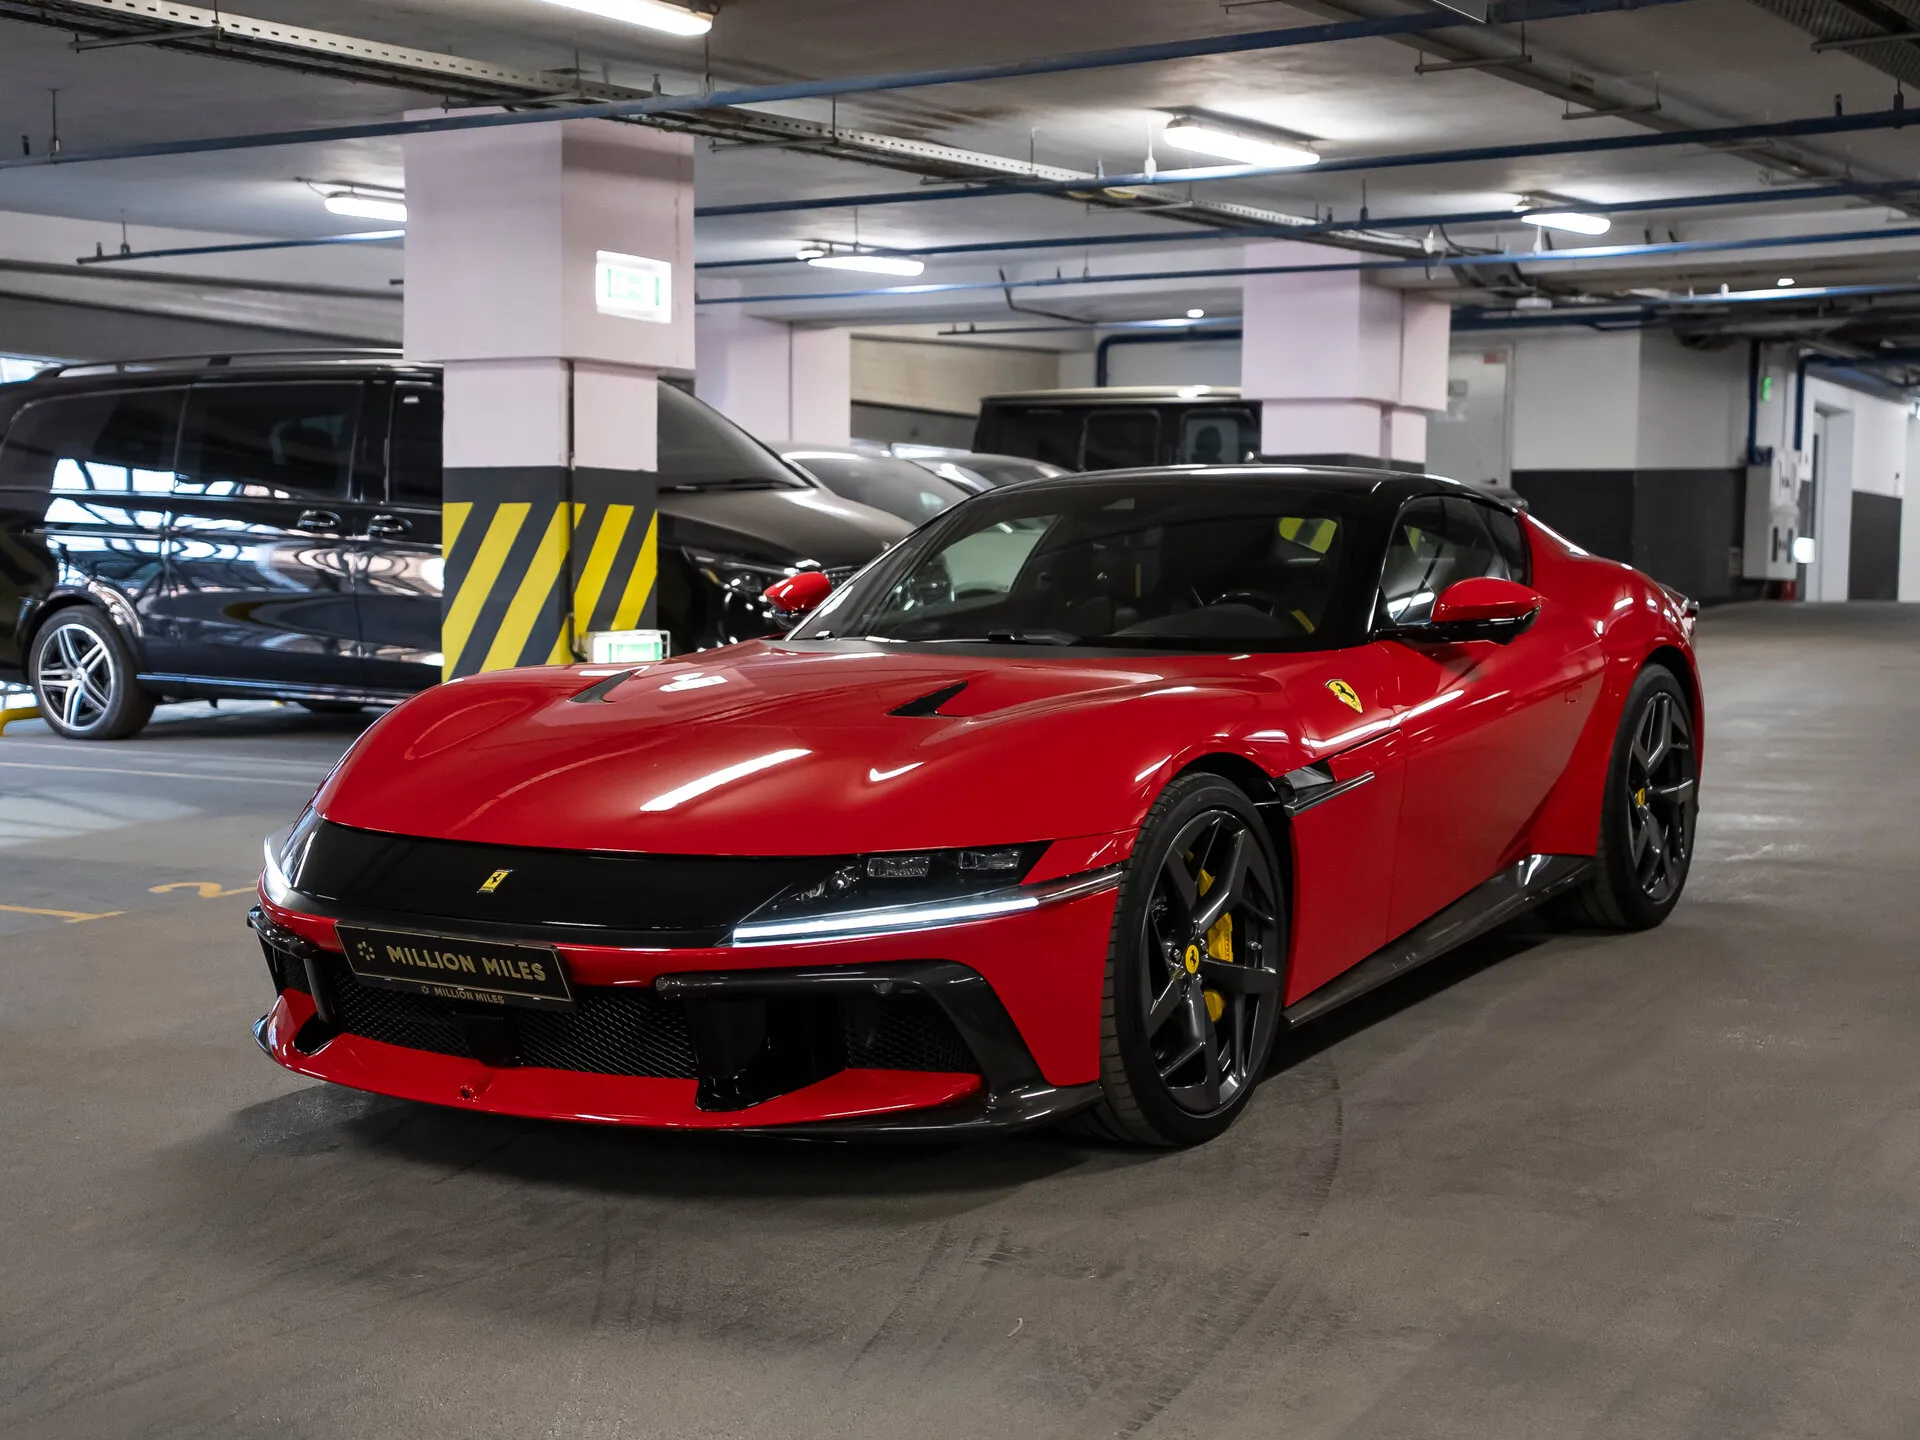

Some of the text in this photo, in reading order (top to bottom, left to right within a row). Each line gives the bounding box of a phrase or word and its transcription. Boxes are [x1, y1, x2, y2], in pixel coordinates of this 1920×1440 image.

[386, 945, 546, 982] MILLION MILES
[433, 987, 505, 1005] MILLION MILES
